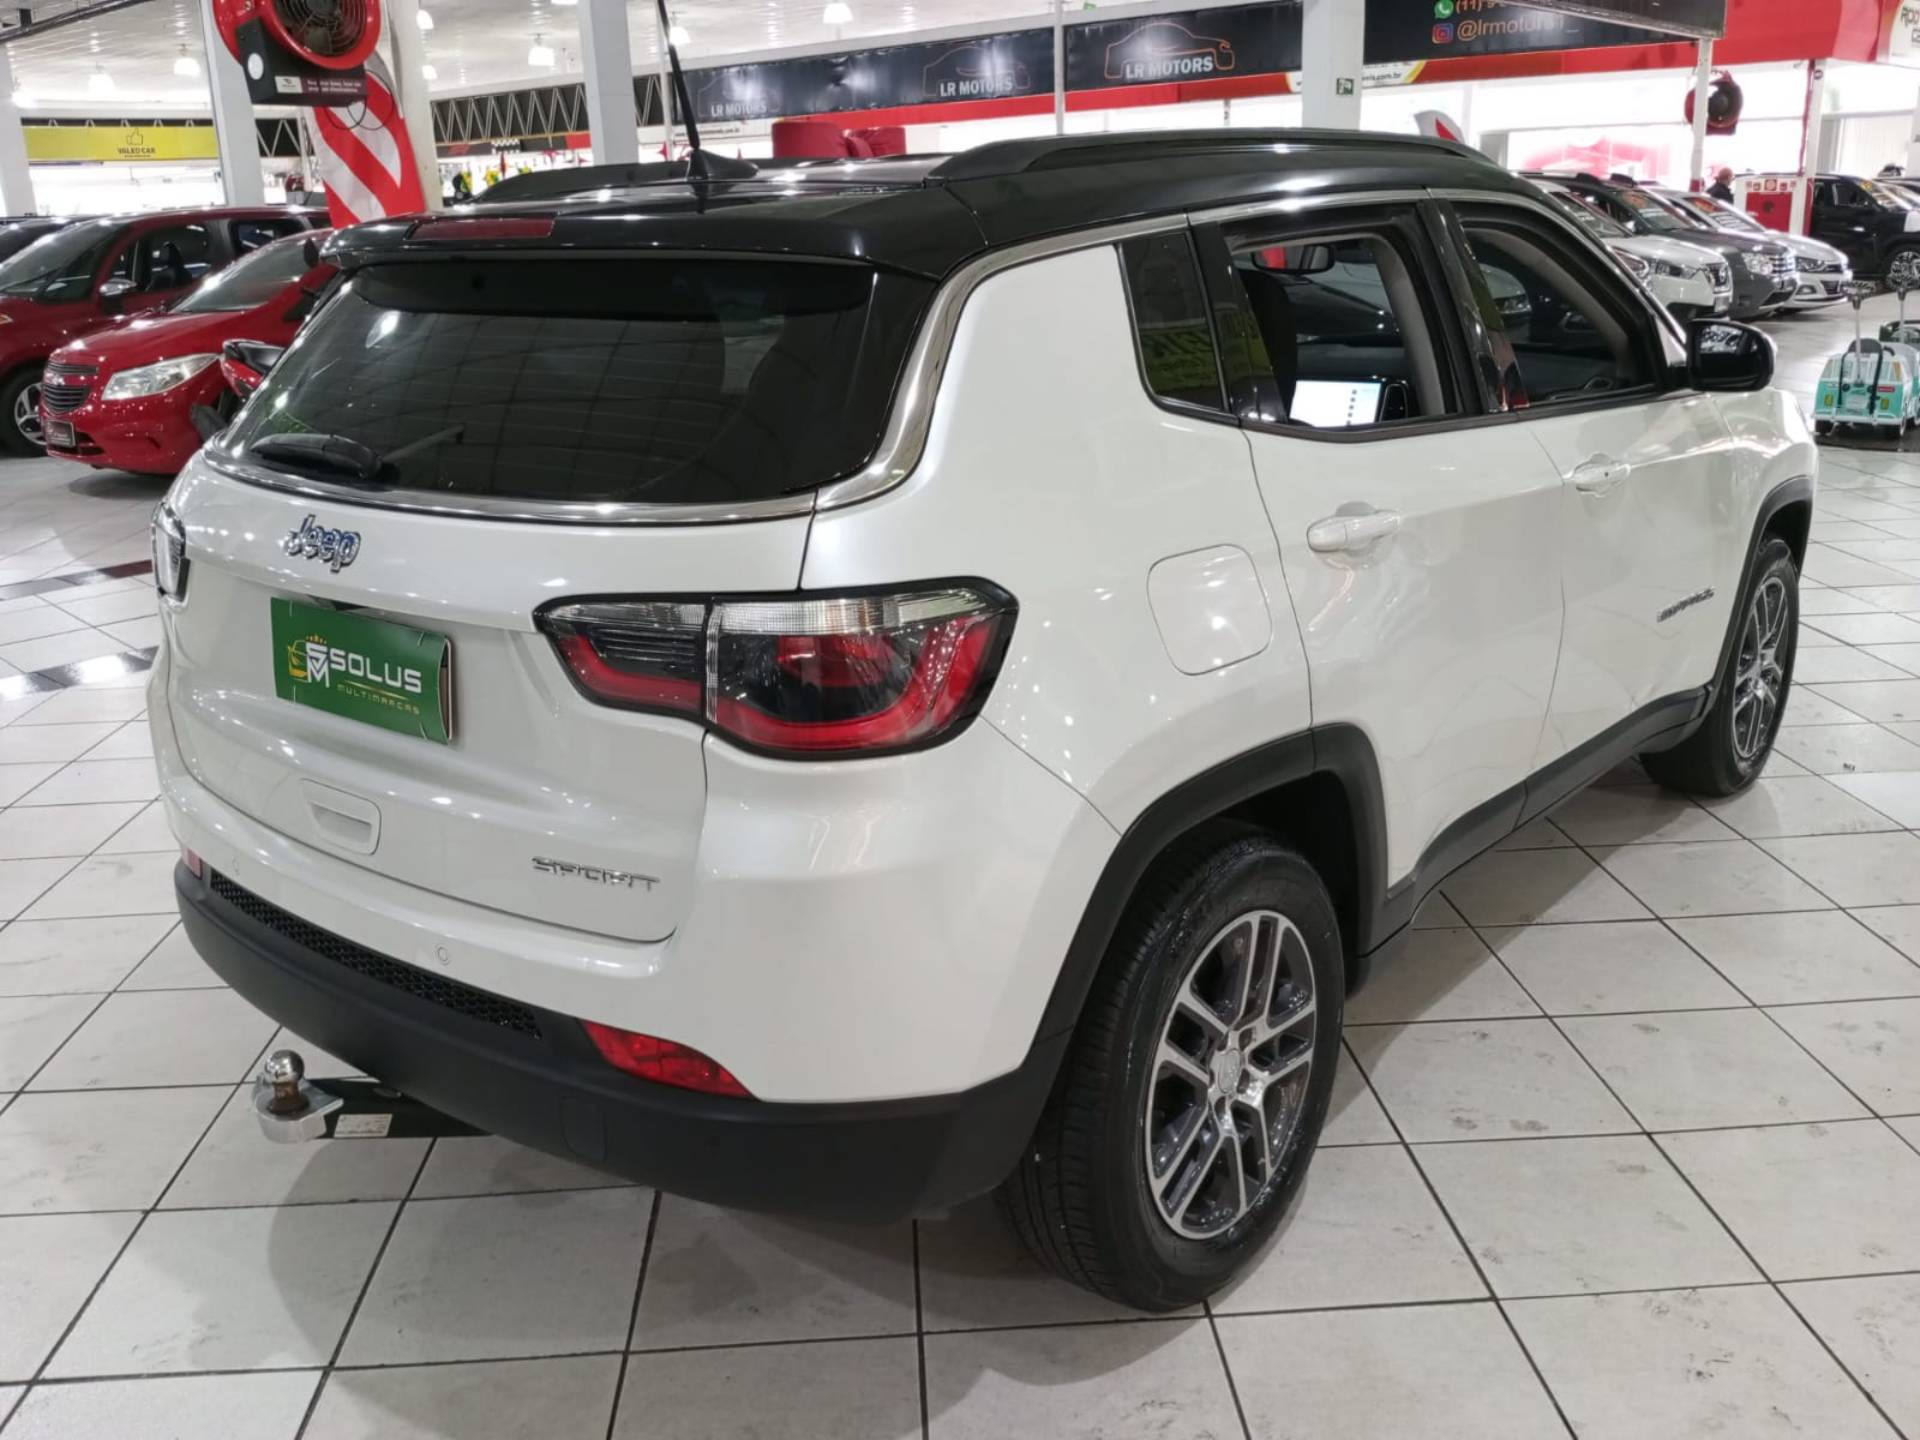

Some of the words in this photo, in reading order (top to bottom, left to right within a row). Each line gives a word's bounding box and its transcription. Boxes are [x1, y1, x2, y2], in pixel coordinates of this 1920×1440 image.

[1126, 63, 1145, 79] LR
[1148, 56, 1214, 77] MOTORS
[940, 82, 957, 97] LR
[959, 78, 1013, 95] MOTORS
[711, 103, 724, 117] LR
[725, 101, 767, 115] MOTORS
[282, 514, 361, 573] Jeep
[329, 648, 422, 693] SOLUS
